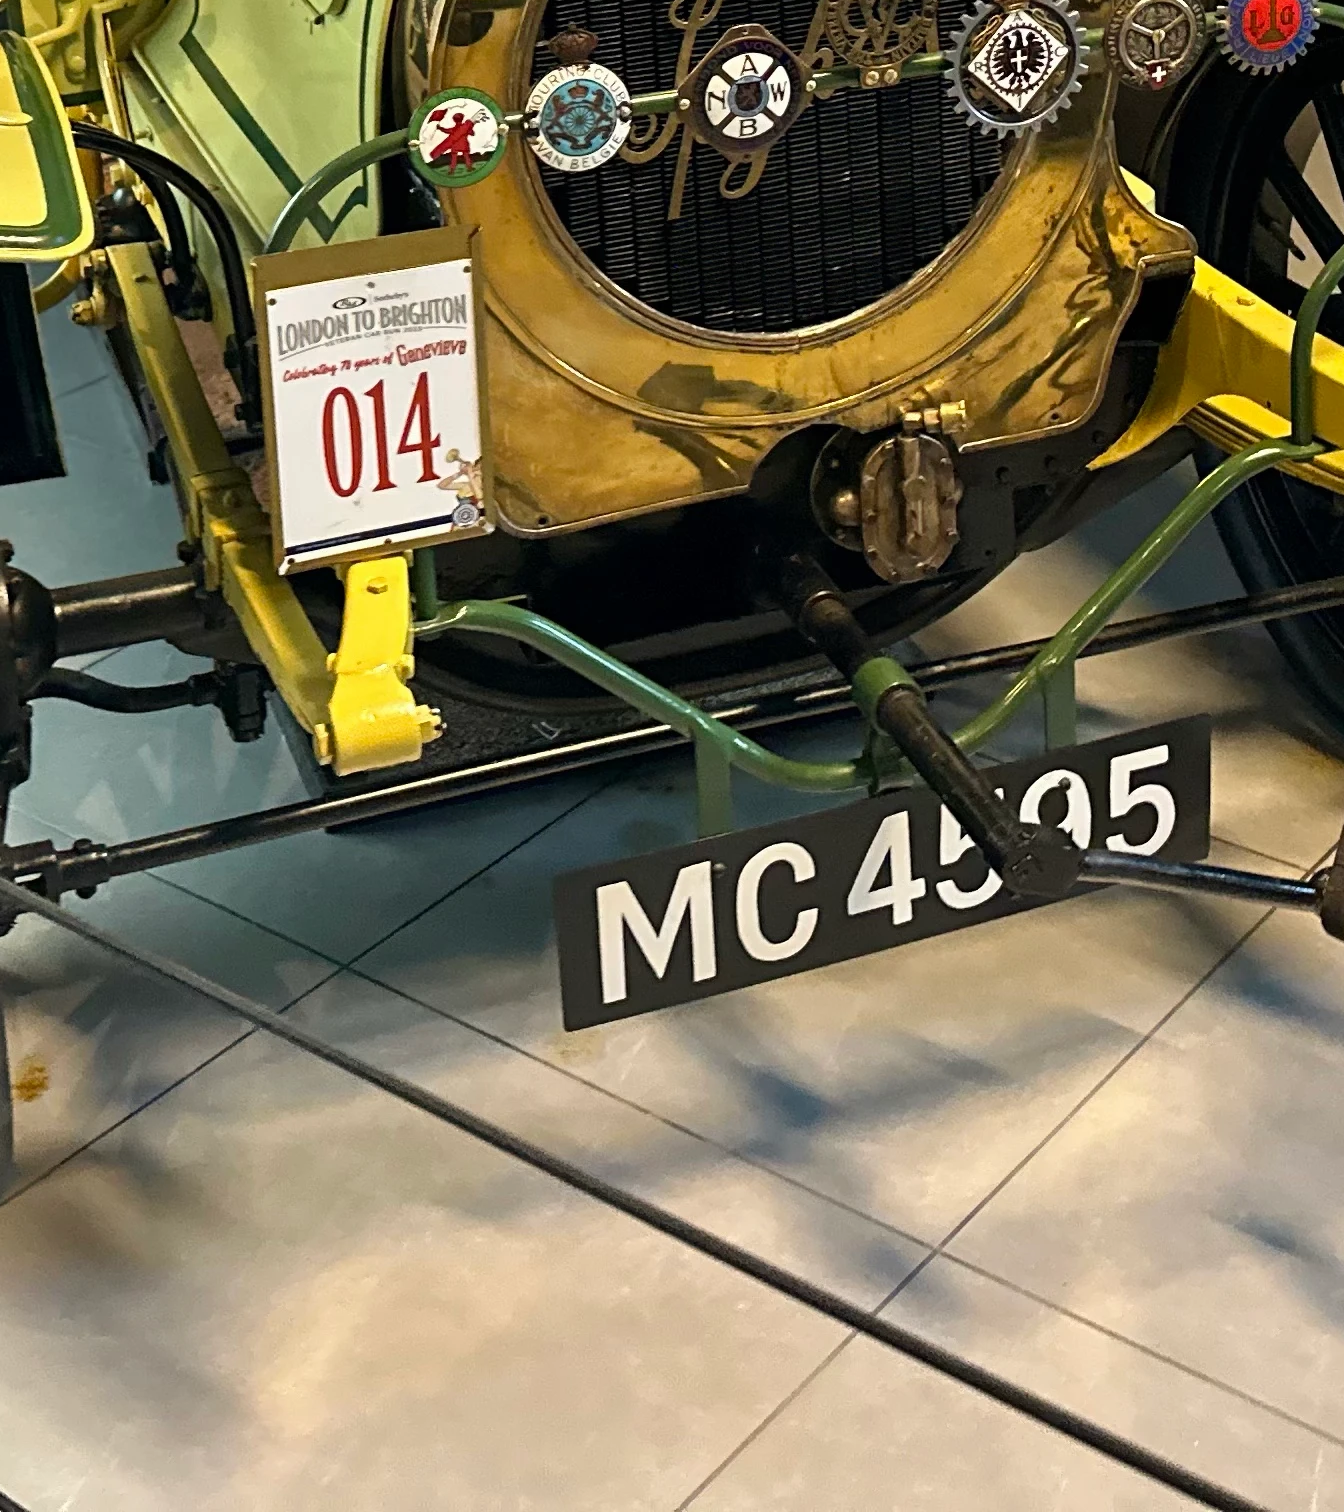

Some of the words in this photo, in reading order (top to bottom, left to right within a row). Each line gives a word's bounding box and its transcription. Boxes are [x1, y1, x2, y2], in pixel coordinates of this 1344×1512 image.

[277, 314, 349, 355] LONDON
[352, 309, 376, 332] TO
[379, 294, 468, 328] BRIGHTON
[282, 364, 339, 382] Celebrating
[354, 356, 381, 372] years
[382, 352, 394, 364] of
[395, 339, 468, 366] Genevieve
[322, 371, 442, 498] 014
[595, 841, 819, 1004] MC
